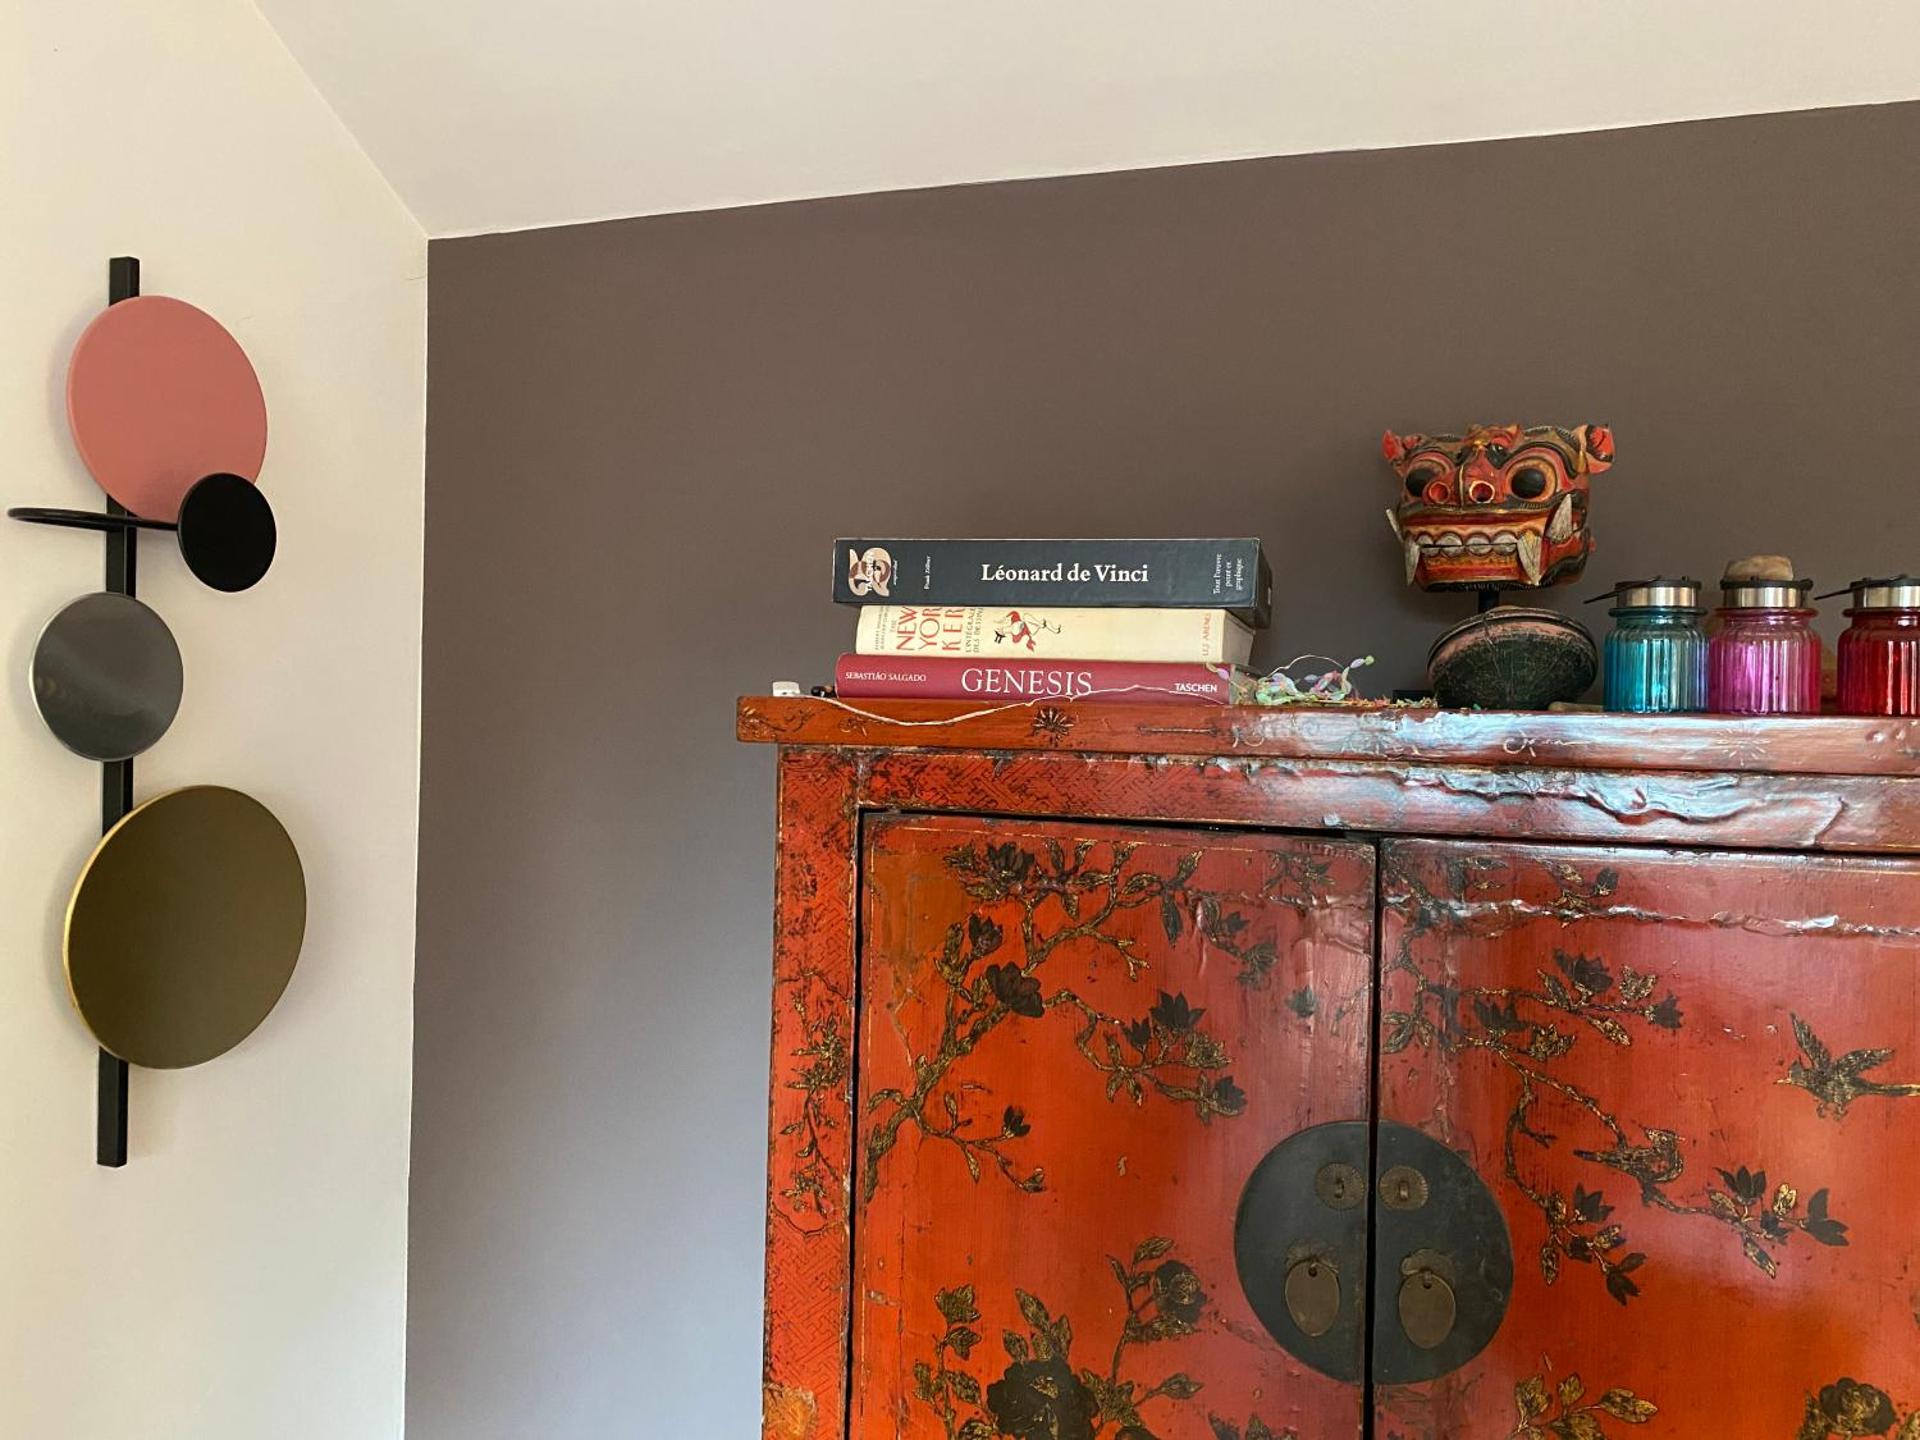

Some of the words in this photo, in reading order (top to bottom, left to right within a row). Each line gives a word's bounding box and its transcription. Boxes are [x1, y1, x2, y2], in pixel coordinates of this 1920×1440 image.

[980, 563, 1063, 582] Léonard
[1067, 563, 1091, 582] de
[1094, 564, 1149, 582] Vinci
[896, 606, 918, 651] NEW
[918, 608, 942, 650] YOR
[942, 608, 964, 651] KER
[888, 673, 927, 682] SALGADO
[961, 668, 1092, 696] GENESIS
[1174, 683, 1218, 693] TASCHEN
